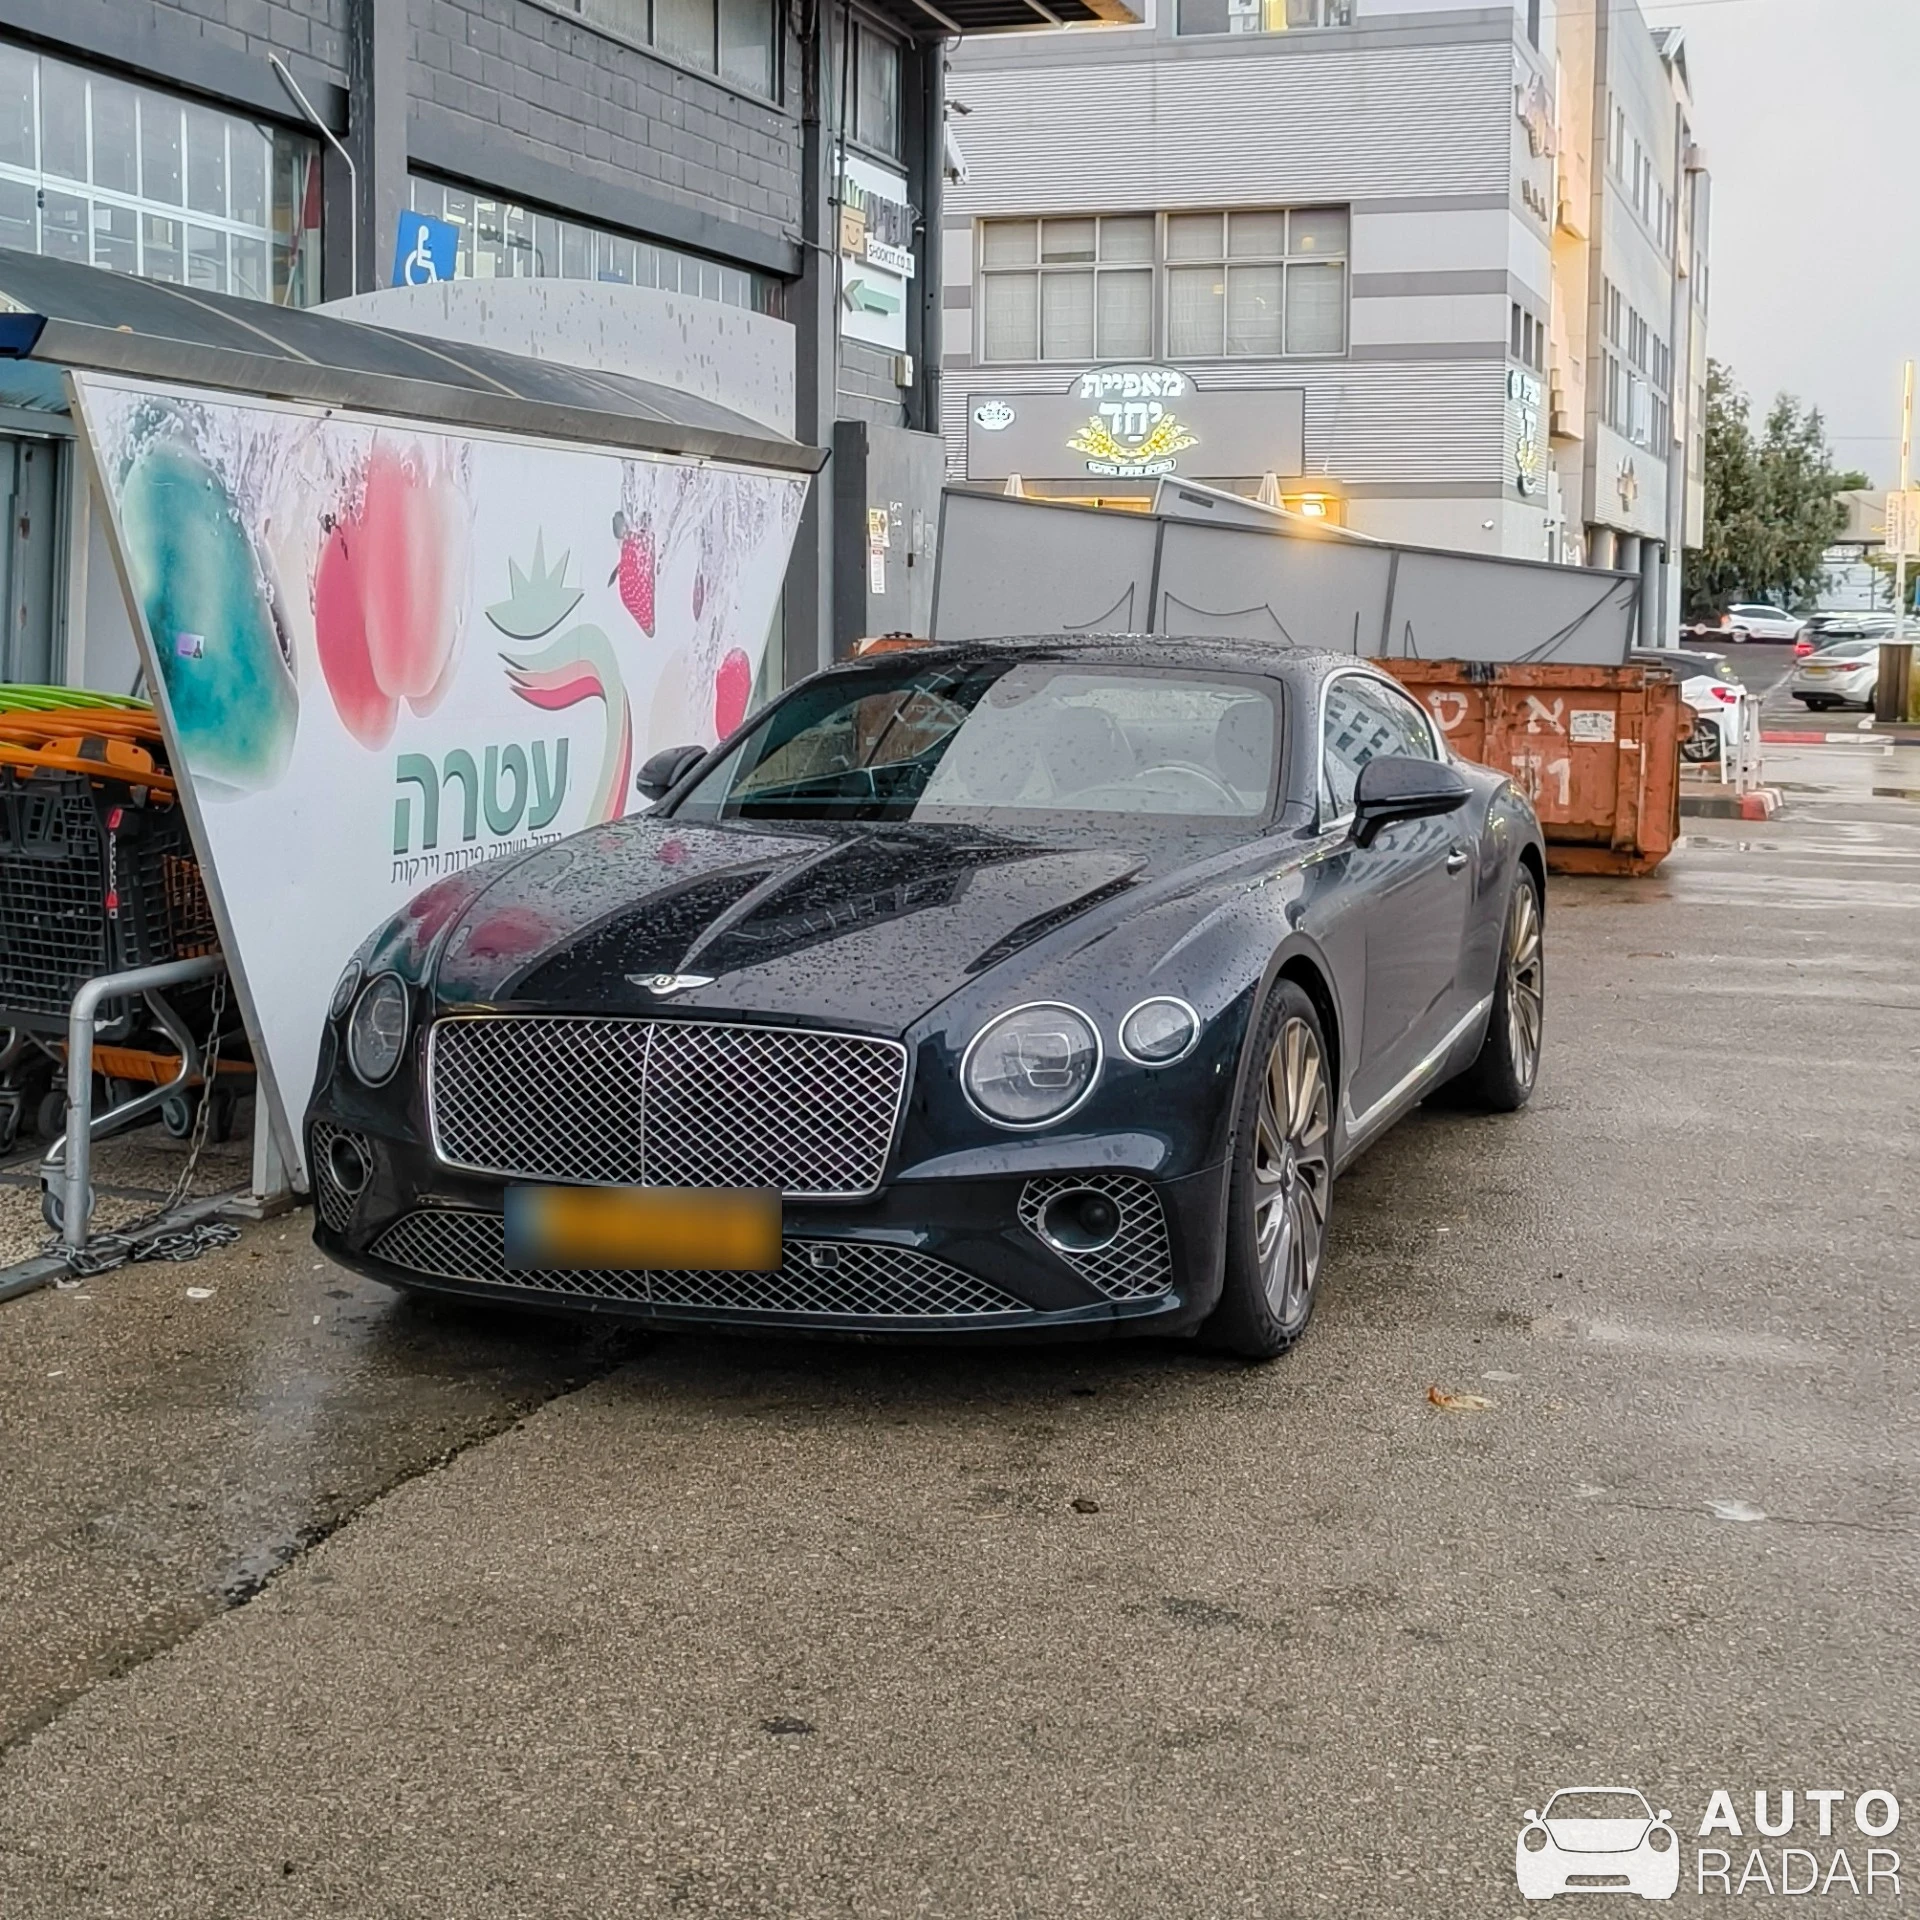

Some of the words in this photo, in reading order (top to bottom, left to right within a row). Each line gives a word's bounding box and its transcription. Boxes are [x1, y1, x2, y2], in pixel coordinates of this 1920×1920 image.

[1080, 371, 1185, 398] מאפיית
[393, 738, 569, 855] עטרה
[391, 855, 440, 886] וירקות
[443, 845, 485, 873] פירות
